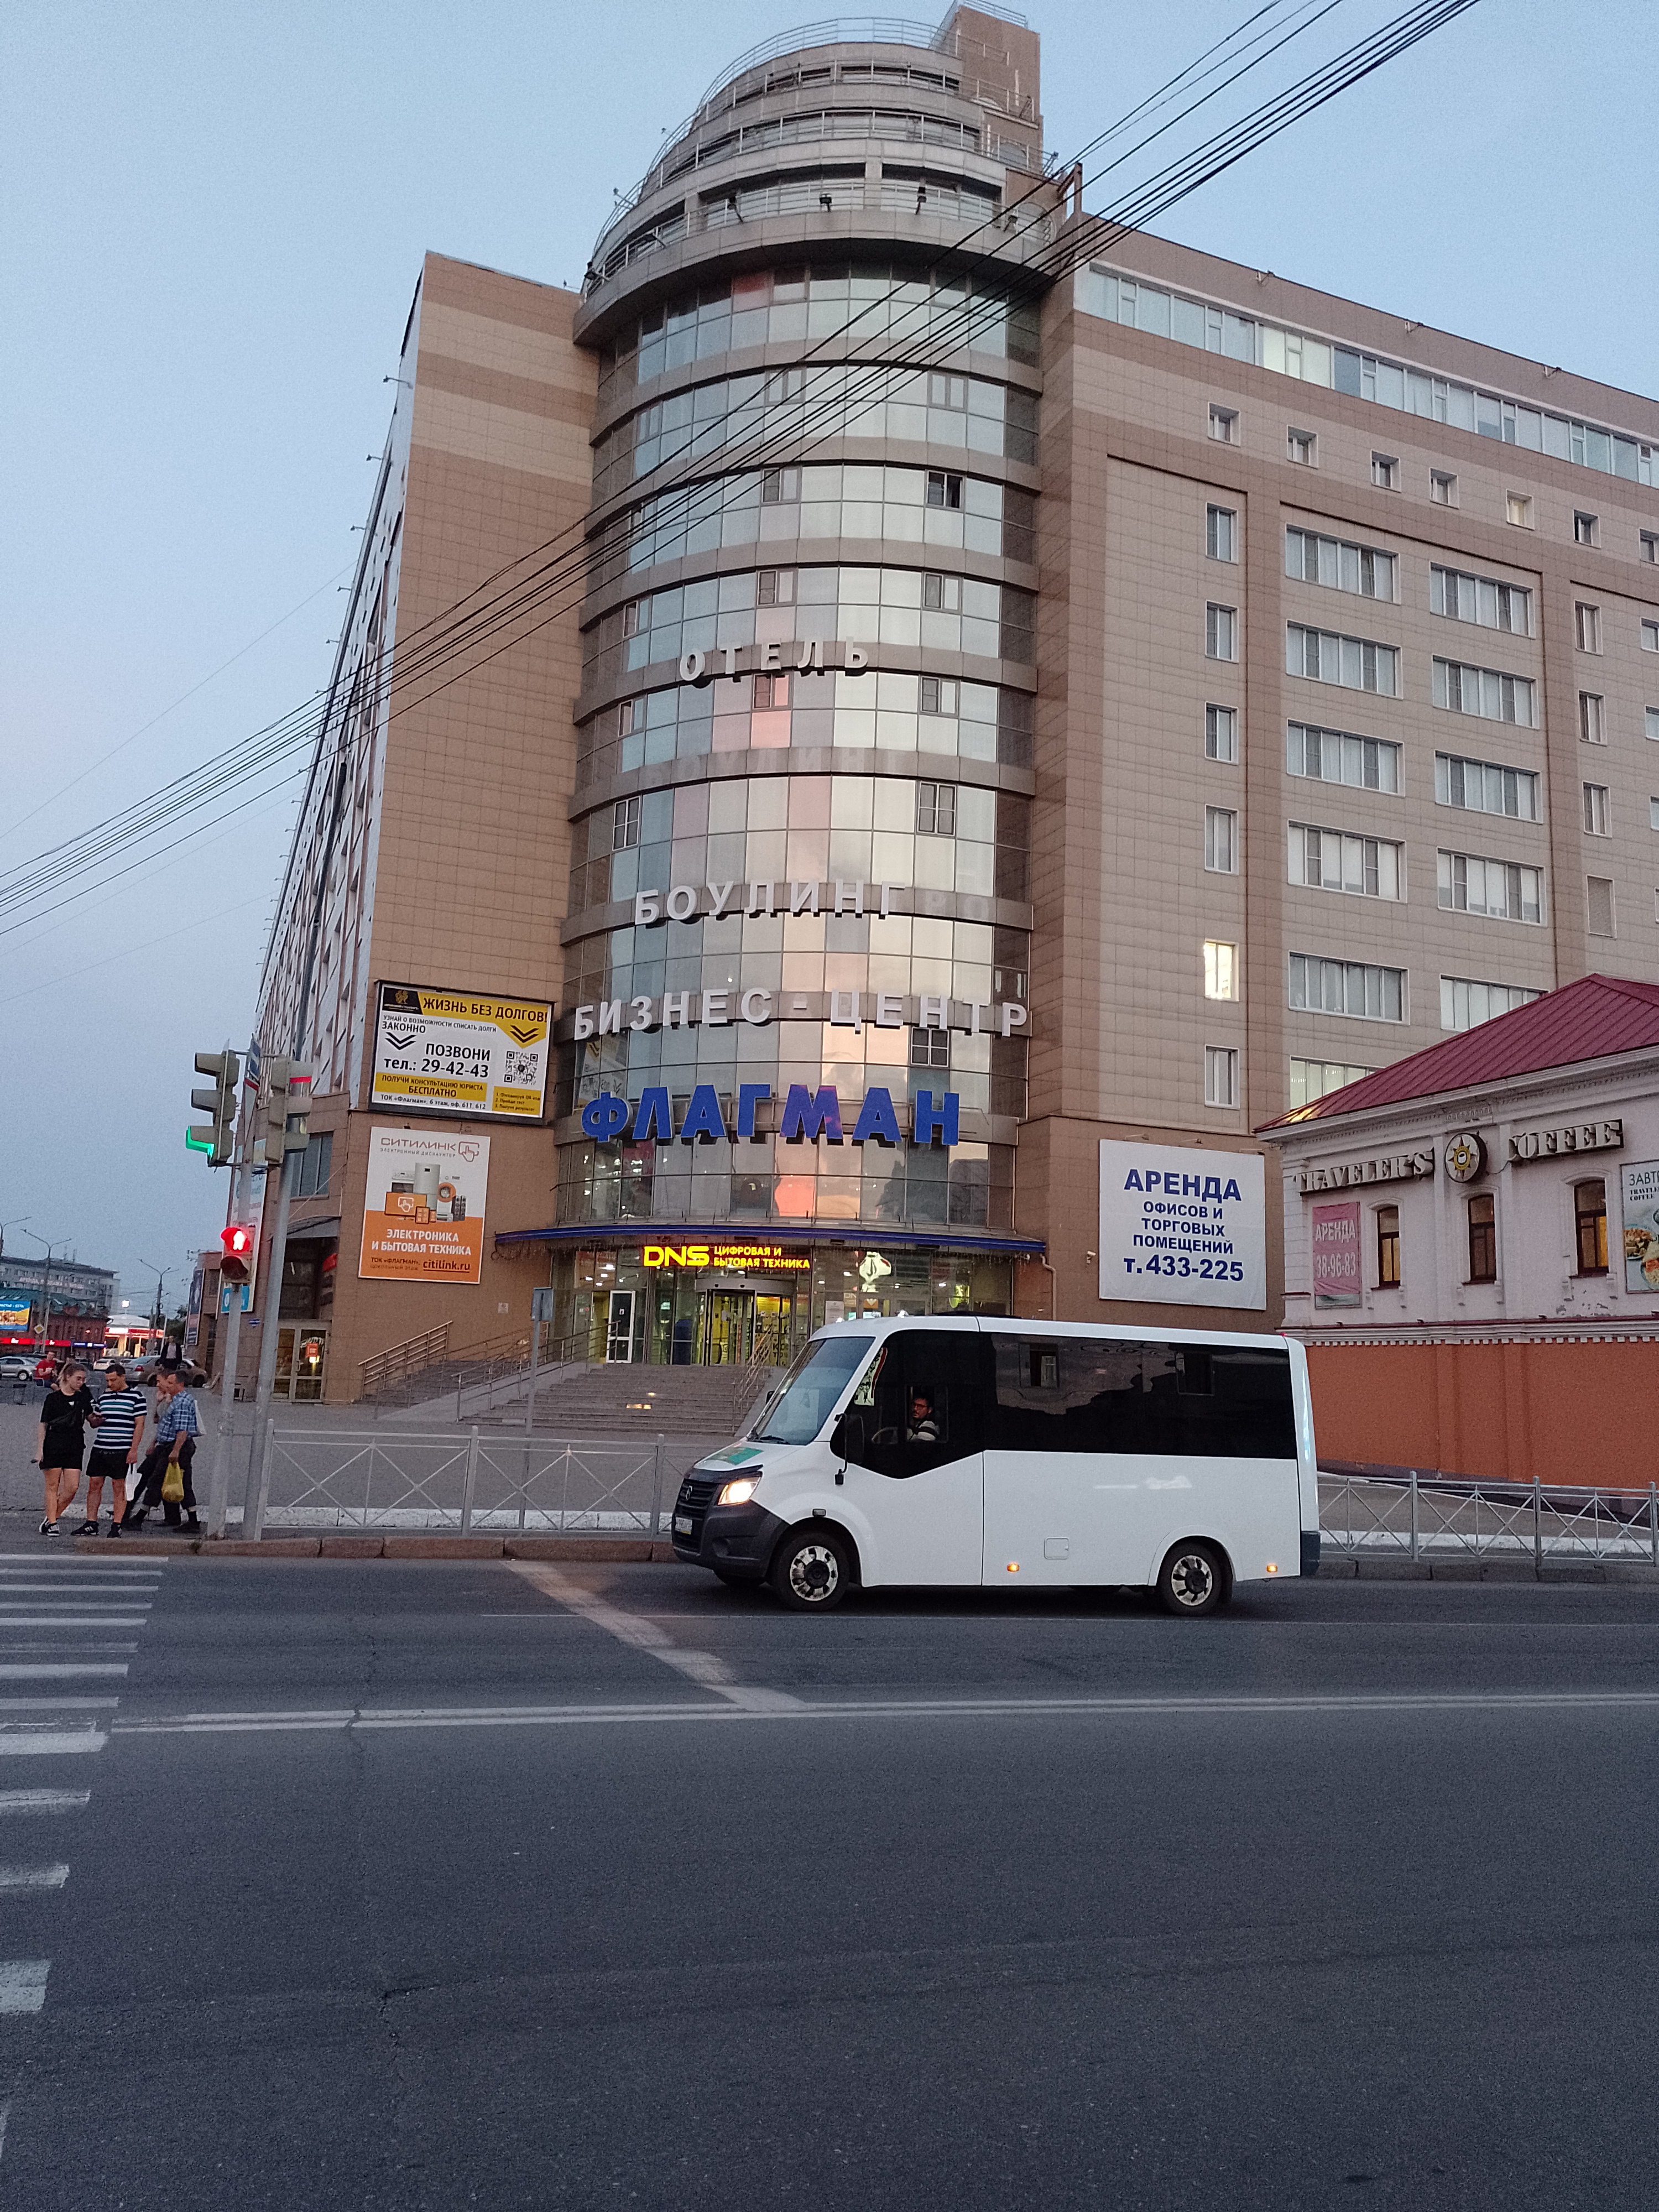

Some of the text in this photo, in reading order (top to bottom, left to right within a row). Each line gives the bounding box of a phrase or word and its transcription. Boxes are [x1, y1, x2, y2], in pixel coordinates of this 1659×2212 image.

[680, 637, 869, 681] ОТЕЛЬ
[635, 878, 905, 925] БОУЛИНГ
[423, 998, 467, 1013] ЖИЗНЬ
[471, 1003, 492, 1016] БЕЗ
[495, 1006, 547, 1023] ДОЛГОВ!
[382, 1021, 426, 1034] ЗАКОННО
[409, 1018, 452, 1027] ВОЗМОЖНОСТИ
[425, 1043, 491, 1061] ПОЗВОНИ
[384, 1058, 489, 1078] тел.: 29-42-43
[382, 1074, 410, 1084] ПОЛУЧИ
[411, 1079, 458, 1088] КОНСУЛЬТАЦИЮ
[408, 1086, 457, 1098] БЕСПЛАТНО
[581, 1084, 960, 1145] ФЛАГМАН
[381, 1138, 456, 1151] СИТИЛИНК
[1507, 1121, 1621, 1161] COFFEE
[1124, 1168, 1241, 1204] АРЕНДА
[1630, 1187, 1659, 1195] TRAVELE
[1143, 1201, 1223, 1220] ОФИСОВ И
[386, 1228, 460, 1242] ЭЛЕКТРОНИКА
[1141, 1217, 1225, 1238] ТОРГОВЫХ
[1316, 1219, 1356, 1244] АРЕНДА
[371, 1240, 472, 1256] И БЫТОВАЯ ТЕХНИКА
[713, 1245, 782, 1256] ЦИФРОВАЯ И
[1133, 1234, 1234, 1255] ПОМЕЩЕНИЙ
[422, 1259, 471, 1270] citilink.ru
[643, 1246, 710, 1266] DNS
[713, 1257, 810, 1269] БЫТОВАЯ ТЕХНИКА
[1316, 1251, 1356, 1279] 38-96-83
